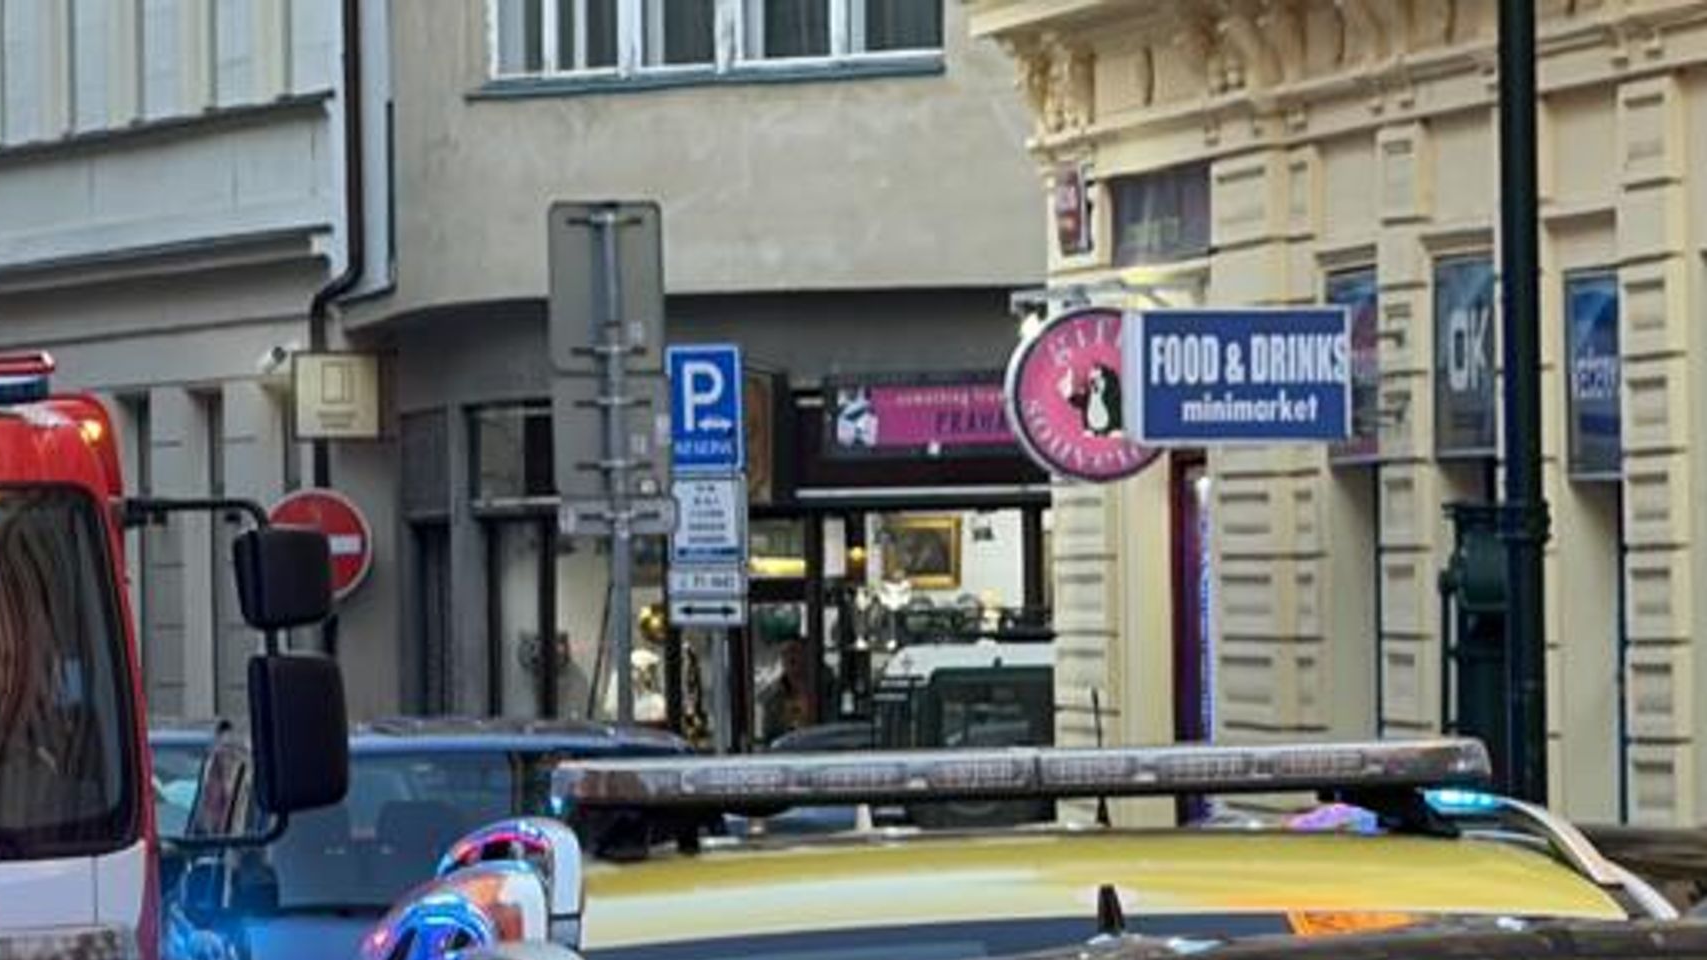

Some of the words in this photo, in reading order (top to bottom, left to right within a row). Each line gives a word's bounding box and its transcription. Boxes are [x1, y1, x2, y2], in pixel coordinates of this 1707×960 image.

[1149, 333, 1220, 385] FOOD
[1224, 342, 1244, 384] &
[1250, 332, 1350, 385] DRINKS
[682, 360, 724, 432] P
[1181, 389, 1319, 423] minimarket
